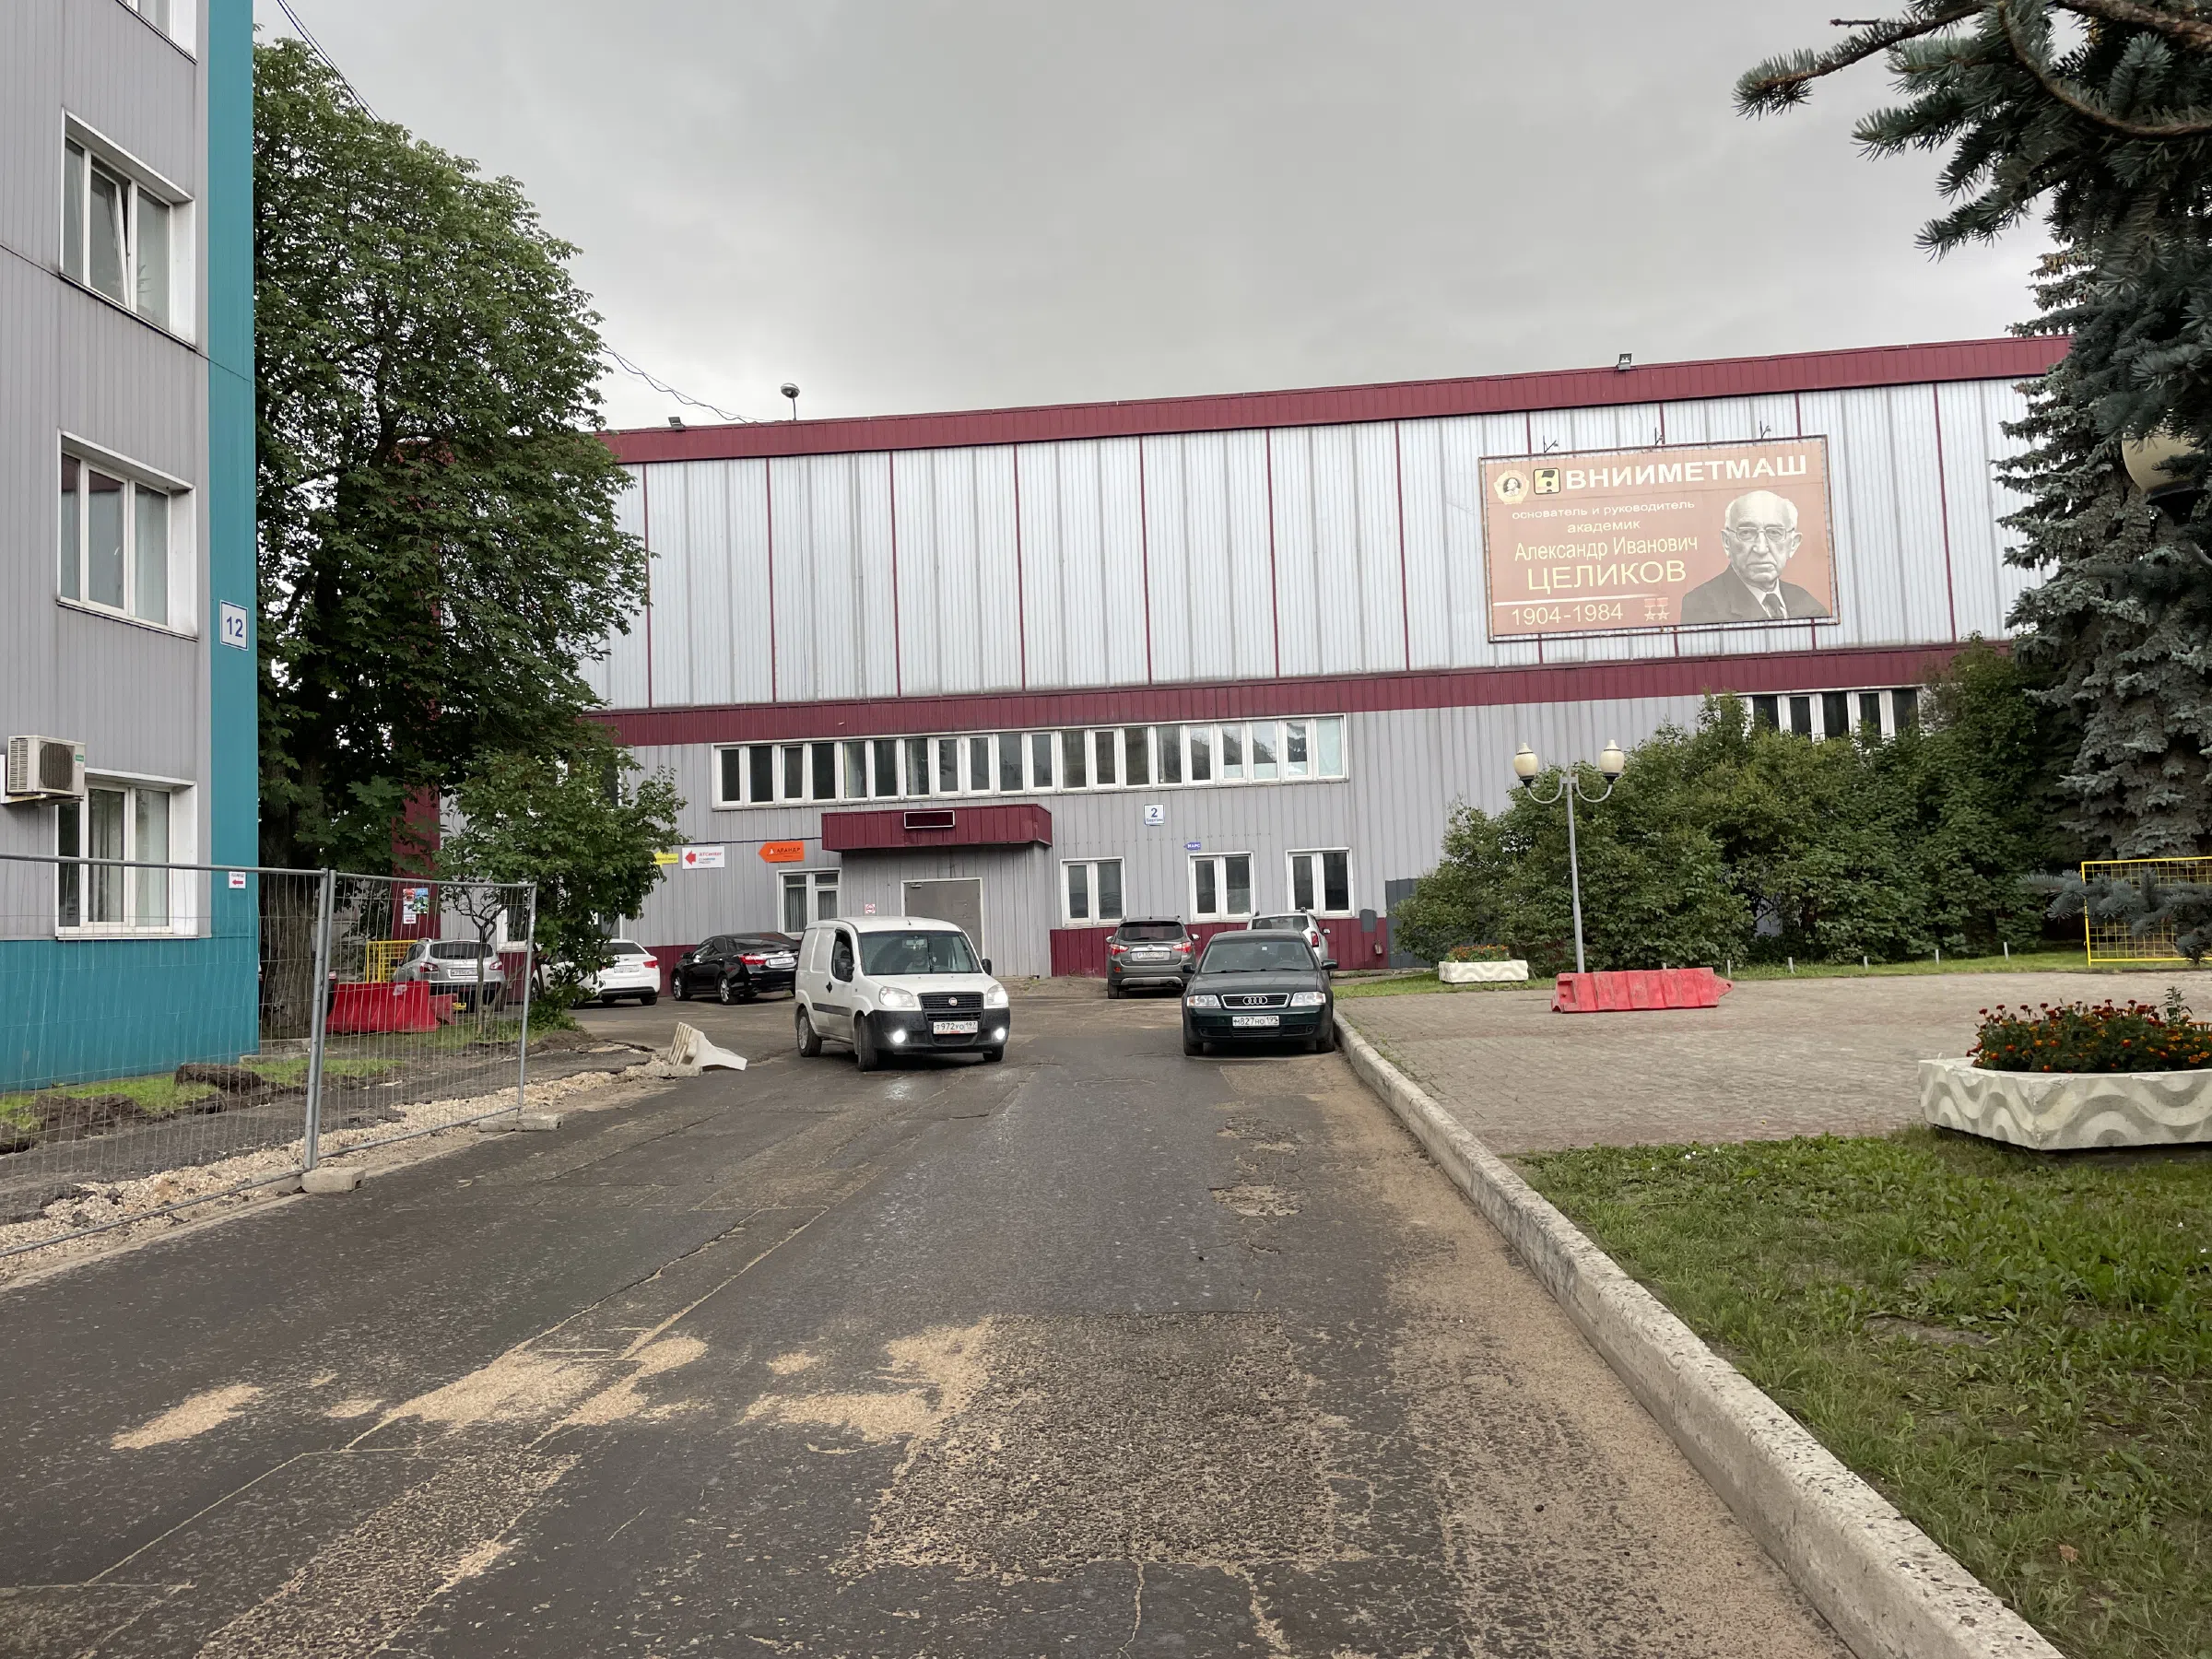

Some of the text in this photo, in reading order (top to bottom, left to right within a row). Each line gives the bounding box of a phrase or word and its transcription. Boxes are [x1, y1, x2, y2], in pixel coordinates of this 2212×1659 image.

[1565, 454, 1807, 490] ВНИИМЕТМАШ
[1512, 508, 1588, 520] основатель
[1604, 500, 1695, 516] руководитель
[1567, 520, 1641, 534] академик
[1514, 535, 1699, 560] Александр Иванович
[1527, 559, 1687, 594] ЦЕЛИКОВ
[1511, 602, 1624, 626] 1904-1984
[226, 616, 243, 638] 12
[1150, 807, 1159, 818] 2
